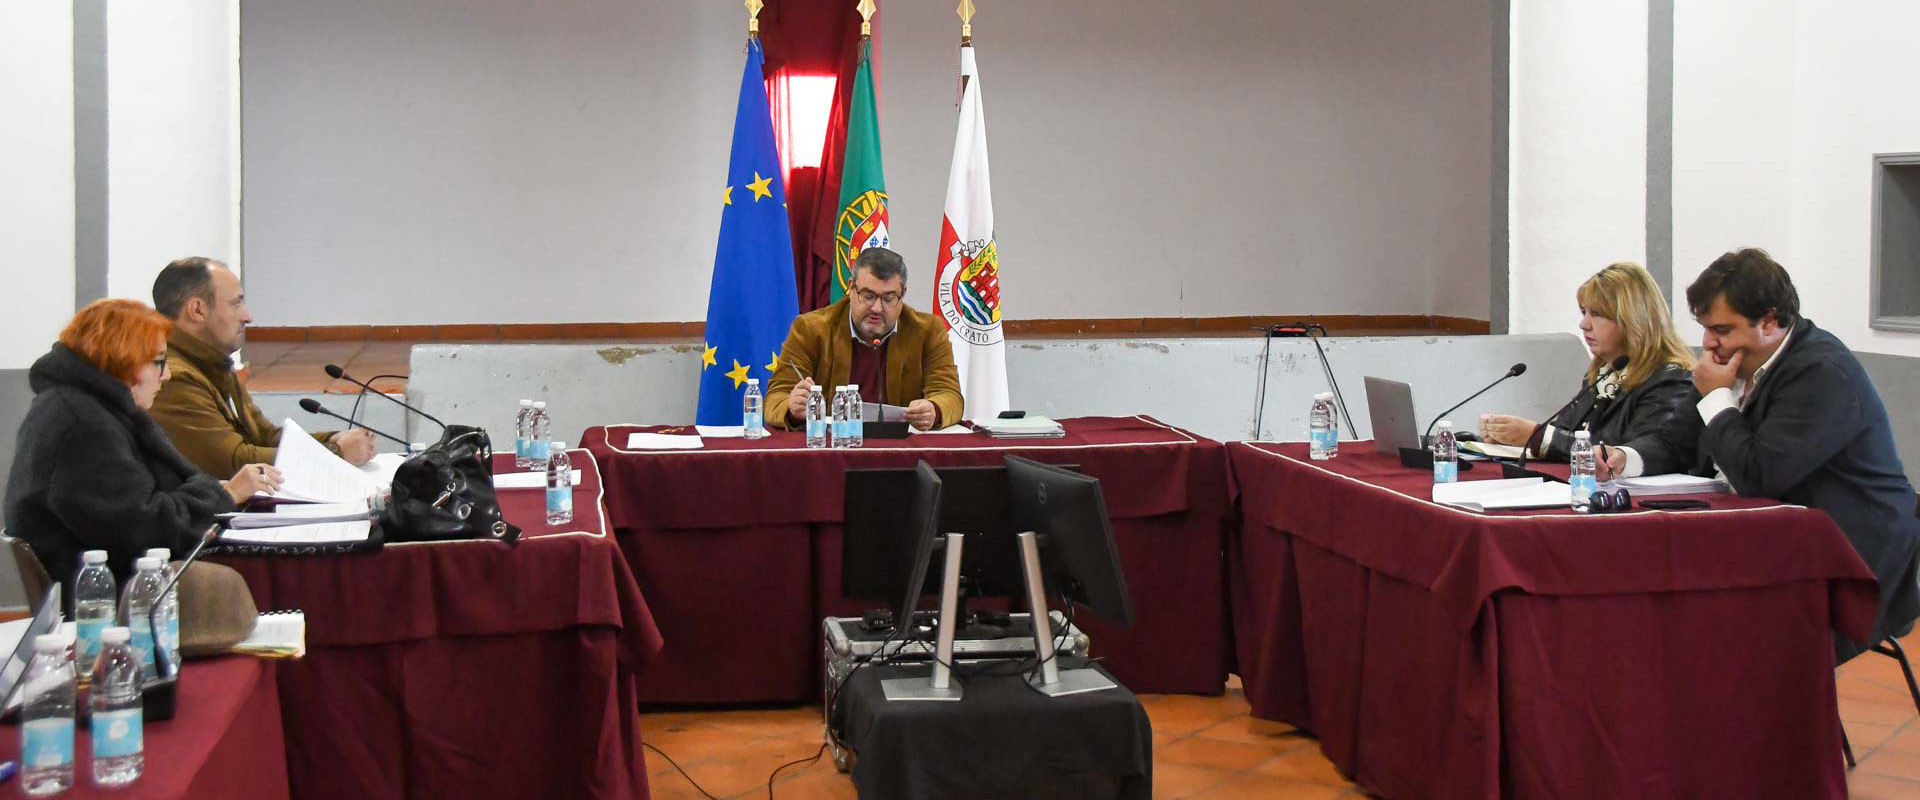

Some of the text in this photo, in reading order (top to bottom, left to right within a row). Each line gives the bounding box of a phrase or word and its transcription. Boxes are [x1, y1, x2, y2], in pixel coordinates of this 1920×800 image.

[940, 282, 989, 343] VILA DO CRATO
